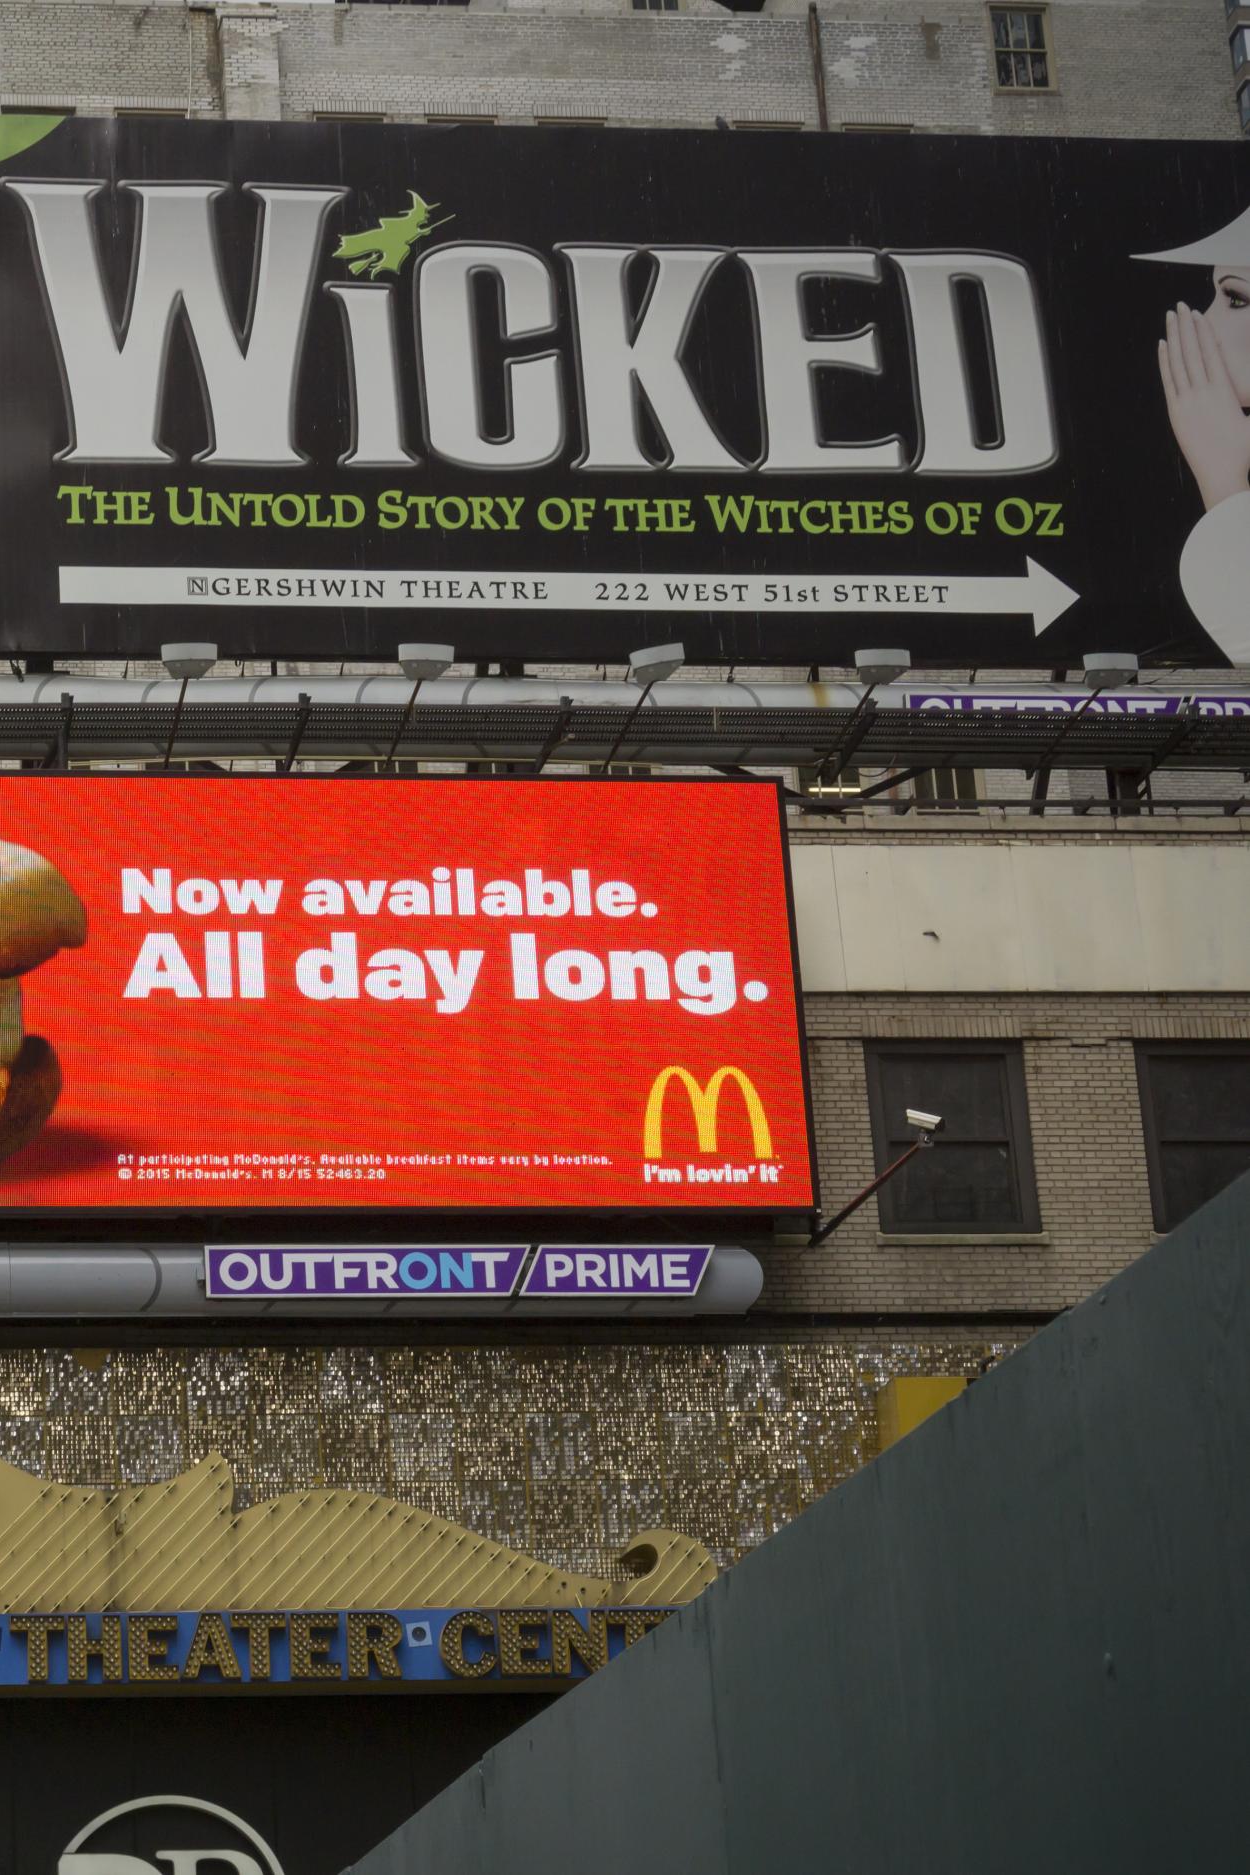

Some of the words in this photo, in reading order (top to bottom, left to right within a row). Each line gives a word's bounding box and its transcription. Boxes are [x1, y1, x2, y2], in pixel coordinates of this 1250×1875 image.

[56, 484, 155, 526] THE
[165, 486, 366, 528] UNTOLD
[377, 489, 525, 531] STORY
[537, 497, 597, 532] OF
[604, 498, 696, 534] THE
[704, 494, 915, 535] WITCHES
[924, 501, 983, 536] OF
[993, 496, 1065, 537] OZ
[400, 579, 550, 601] THEATRE
[594, 582, 650, 602] 222
[664, 583, 750, 602] WEST
[763, 584, 821, 603] 51st
[833, 584, 951, 604] STREET
[121, 867, 284, 916] Now
[301, 866, 659, 918] available.
[122, 931, 268, 1001] All
[295, 932, 485, 1015] day
[509, 932, 769, 1017] long.
[117, 1154, 134, 1165] At
[138, 1154, 230, 1167] participating
[233, 1154, 316, 1166] McDonald's.
[320, 1153, 382, 1166] Available
[386, 1154, 453, 1165] breakfast
[457, 1154, 495, 1165] items
[501, 1156, 529, 1167] vary
[534, 1154, 550, 1166] by
[553, 1153, 613, 1166] location.
[137, 1168, 171, 1180] 2015
[175, 1168, 258, 1180] McDonald's.
[686, 1163, 757, 1183] lovin'
[218, 1251, 512, 1291] OUTFRONT
[544, 1252, 692, 1289] PRIME
[9, 1610, 404, 1681] THEATER
